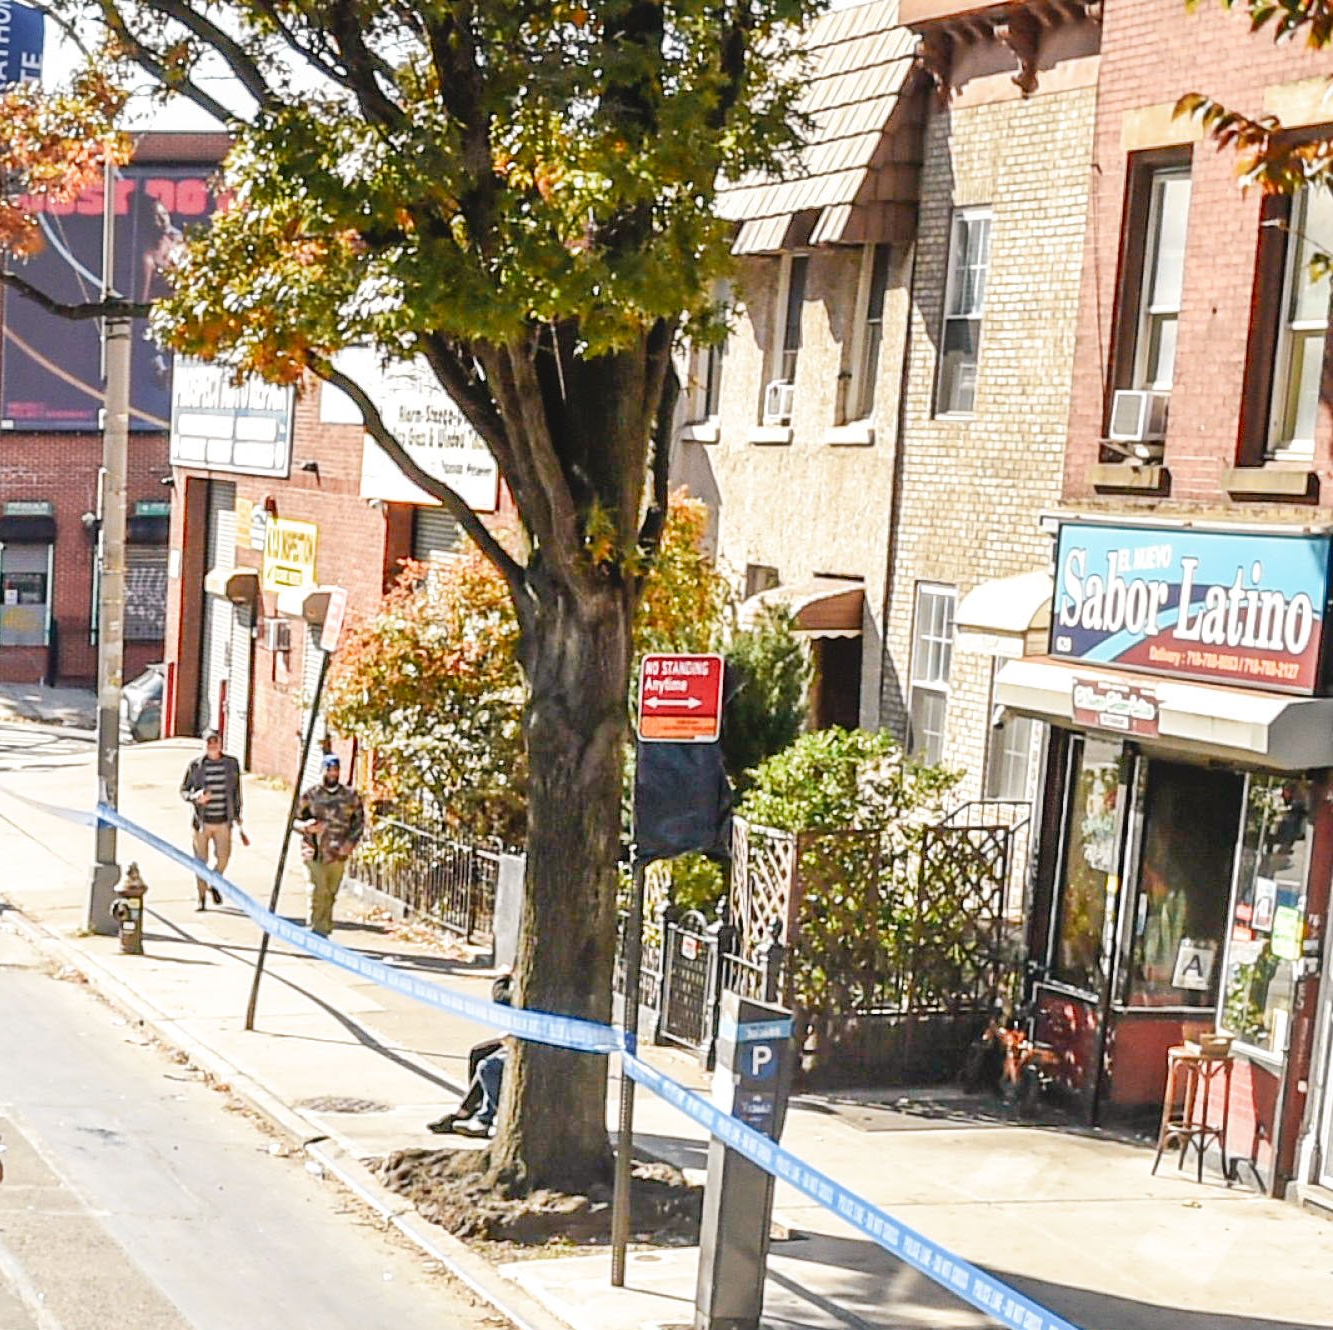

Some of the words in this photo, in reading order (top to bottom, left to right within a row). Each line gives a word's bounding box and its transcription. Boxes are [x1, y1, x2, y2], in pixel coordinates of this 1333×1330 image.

[19, 52, 44, 84] TE
[1116, 549, 1132, 573] EL
[1058, 546, 1170, 637] Sabor
[1172, 555, 1314, 656] Latino
[644, 660, 659, 676] NO
[660, 660, 710, 676] STANDING
[644, 676, 688, 696] Anytime
[1181, 953, 1205, 979] A
[752, 1045, 773, 1076] P
